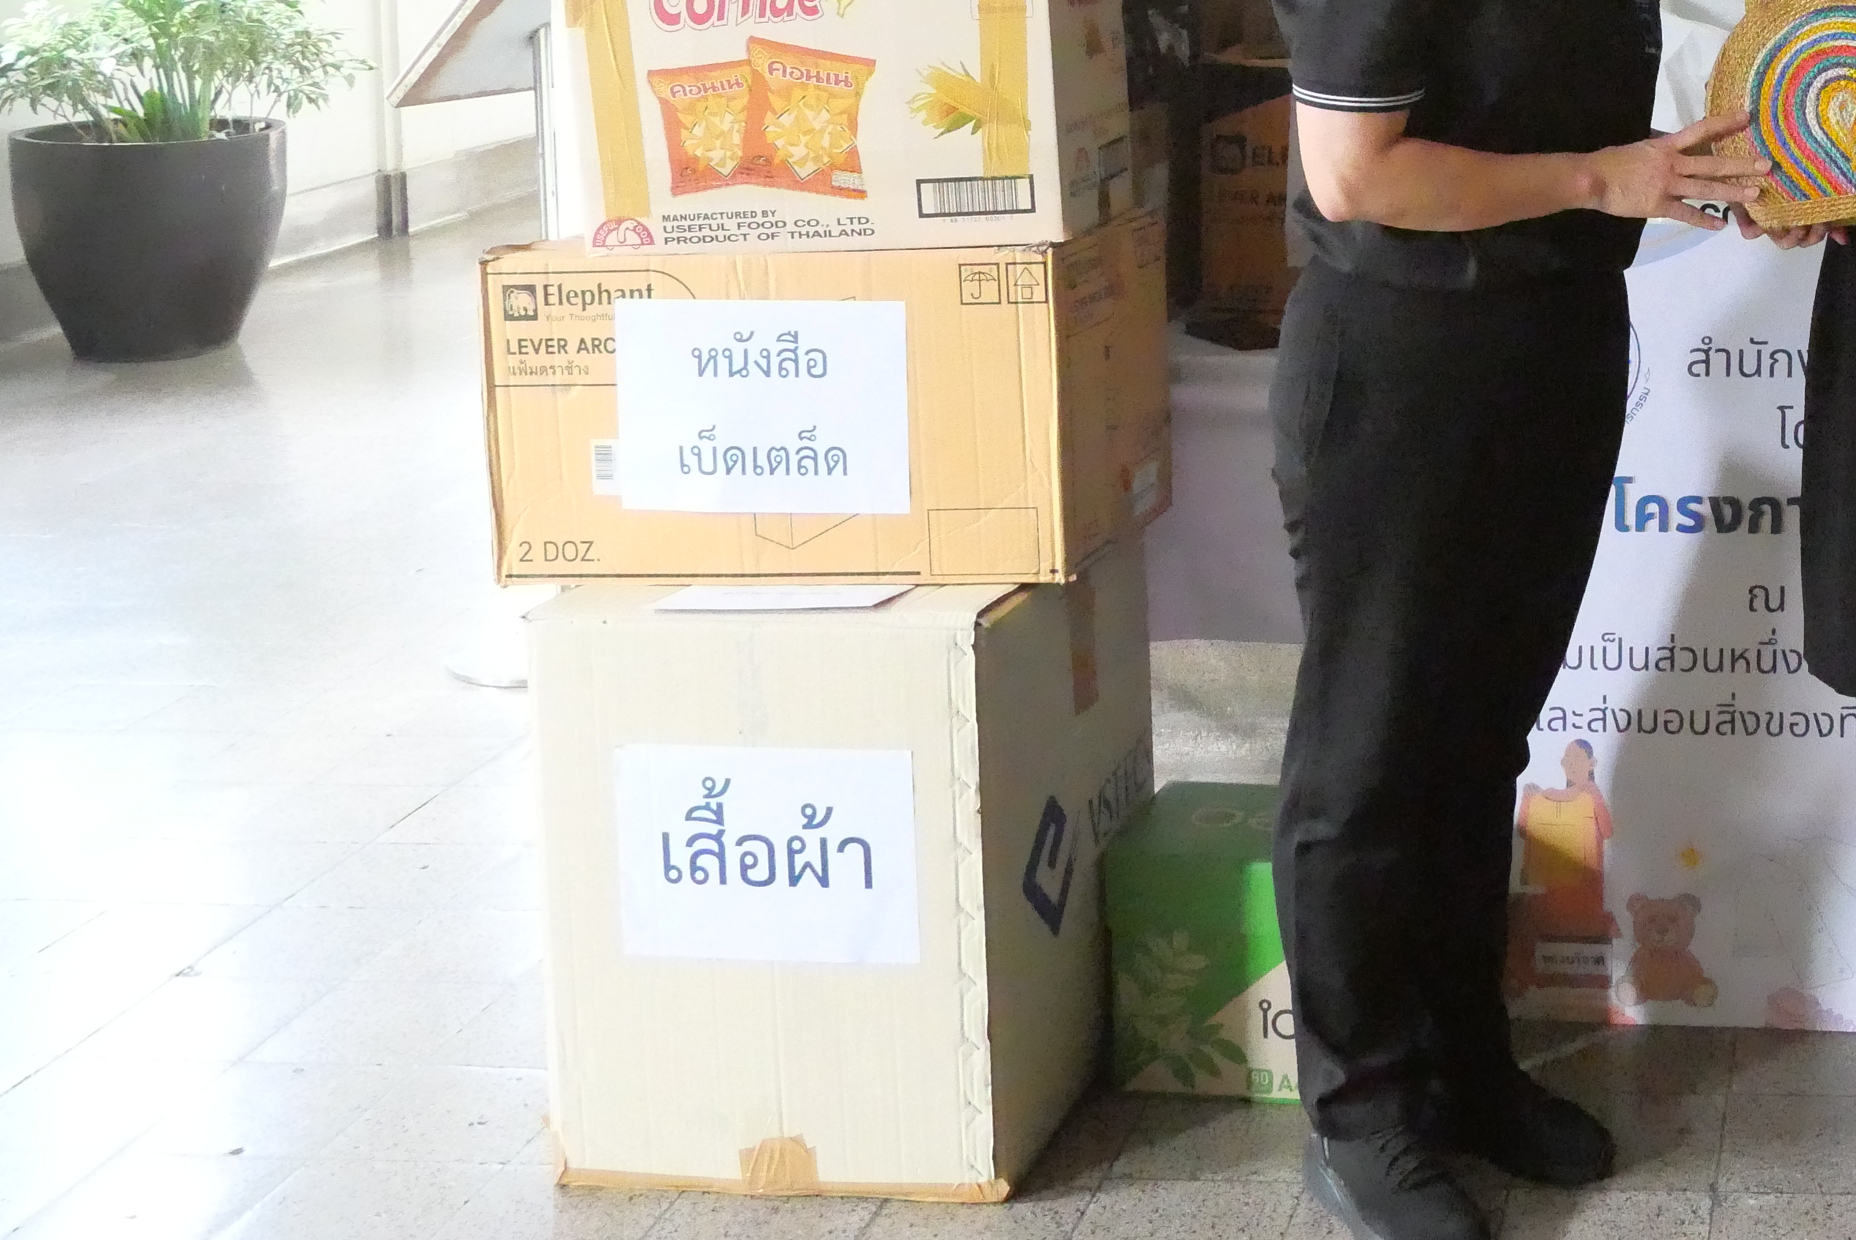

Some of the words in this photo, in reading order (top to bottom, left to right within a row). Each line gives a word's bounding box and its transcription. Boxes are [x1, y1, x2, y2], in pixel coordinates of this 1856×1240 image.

[662, 210, 758, 223] MANUFACTURED
[761, 209, 777, 220] BY
[663, 222, 731, 235] USEFUL
[737, 219, 787, 231] FOOD
[837, 216, 875, 228] LTD.
[664, 232, 748, 246] PRODUCT
[757, 231, 782, 241] OF
[787, 228, 875, 241] THAILAND
[544, 313, 565, 322] Your
[507, 337, 569, 356] LEVER
[576, 337, 617, 355] ARC
[692, 328, 829, 380] หนังสือ
[679, 425, 849, 479] เบ็ดเตล็ด
[519, 541, 534, 562] 2
[544, 539, 601, 562] DOZ.
[1748, 584, 1785, 612] ณ
[661, 776, 874, 891] เสื้อผ้า
